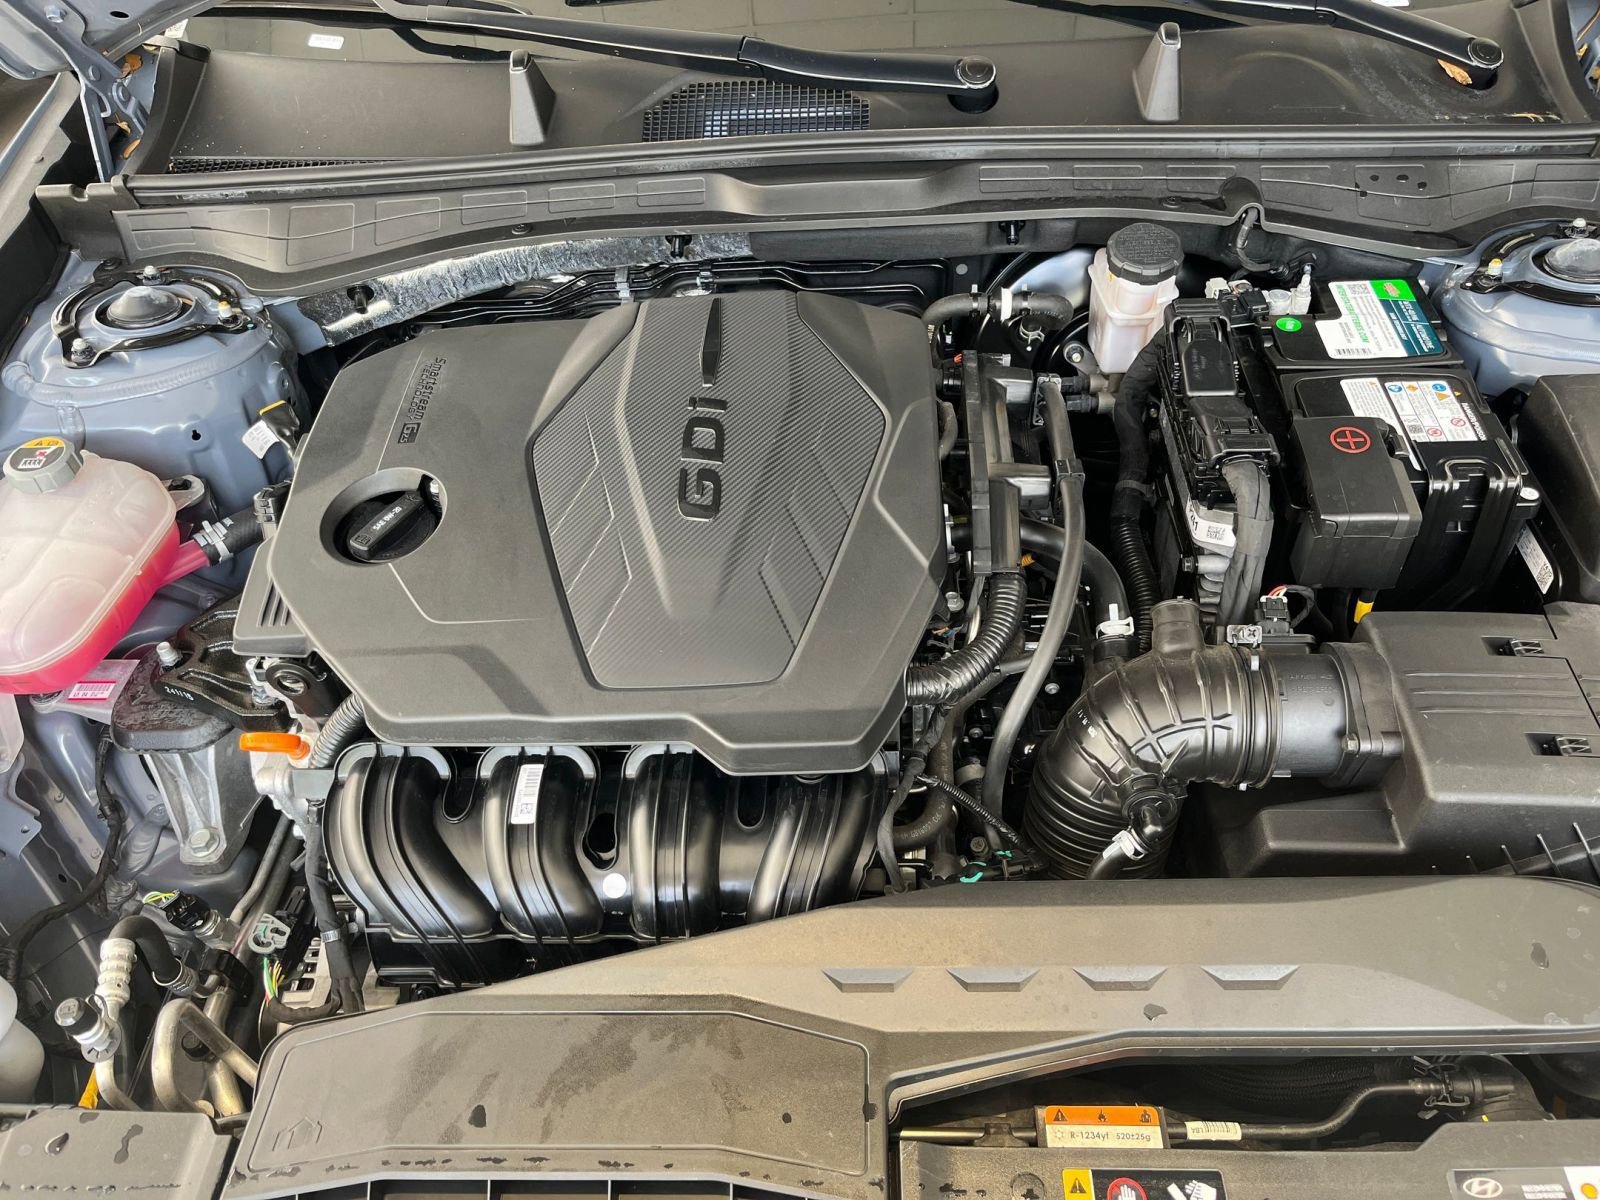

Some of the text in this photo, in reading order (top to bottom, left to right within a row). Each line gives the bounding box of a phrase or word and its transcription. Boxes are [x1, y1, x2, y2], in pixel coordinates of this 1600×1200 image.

[407, 363, 434, 422] TECHNOLOGY
[415, 357, 447, 421] Smartstream
[677, 396, 728, 522] GDi
[1070, 1130, 1152, 1143] R-1234yf 520±25g
